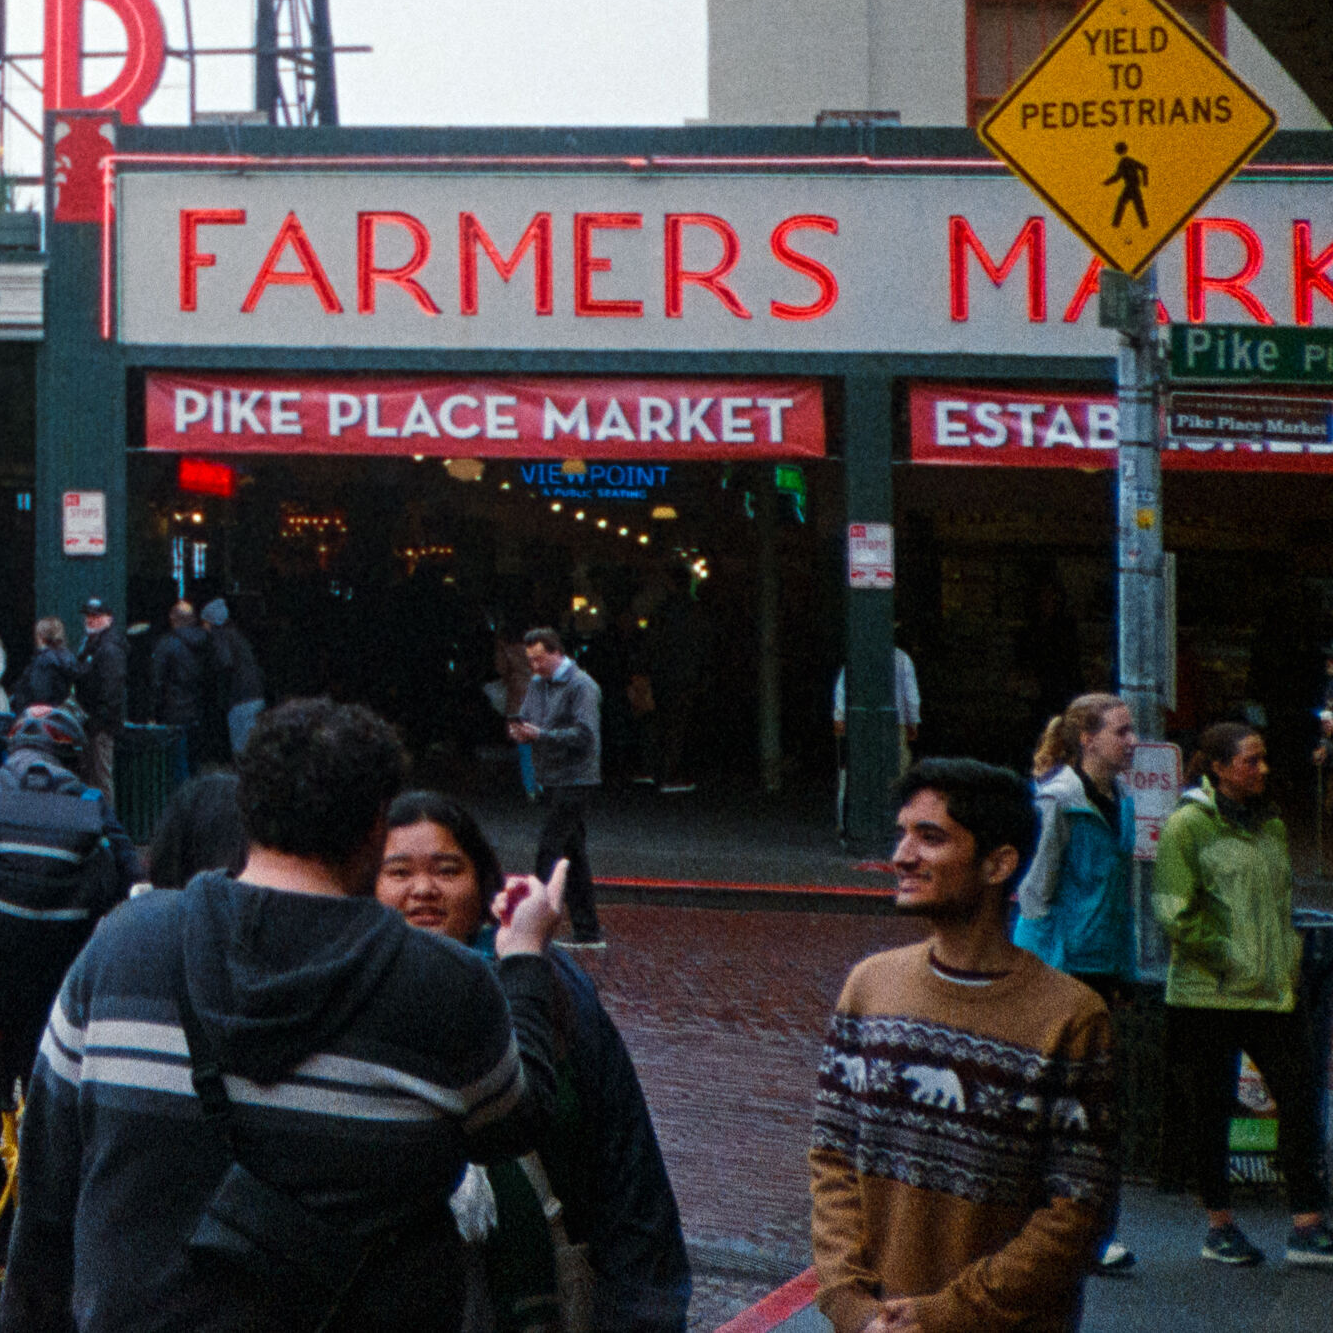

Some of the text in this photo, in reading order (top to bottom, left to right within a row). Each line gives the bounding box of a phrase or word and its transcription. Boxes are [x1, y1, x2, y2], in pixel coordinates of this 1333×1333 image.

[1084, 26, 1169, 56] YIELD
[1108, 63, 1144, 90] TO
[1021, 95, 1233, 130] PEDESTRIANS
[178, 208, 840, 321] FARMERS
[1186, 327, 1280, 372] Pike
[173, 387, 793, 445] PIKE PLACE MARKET
[1176, 414, 1328, 435] Pike Place Market
[1122, 769, 1172, 791] TOPS
